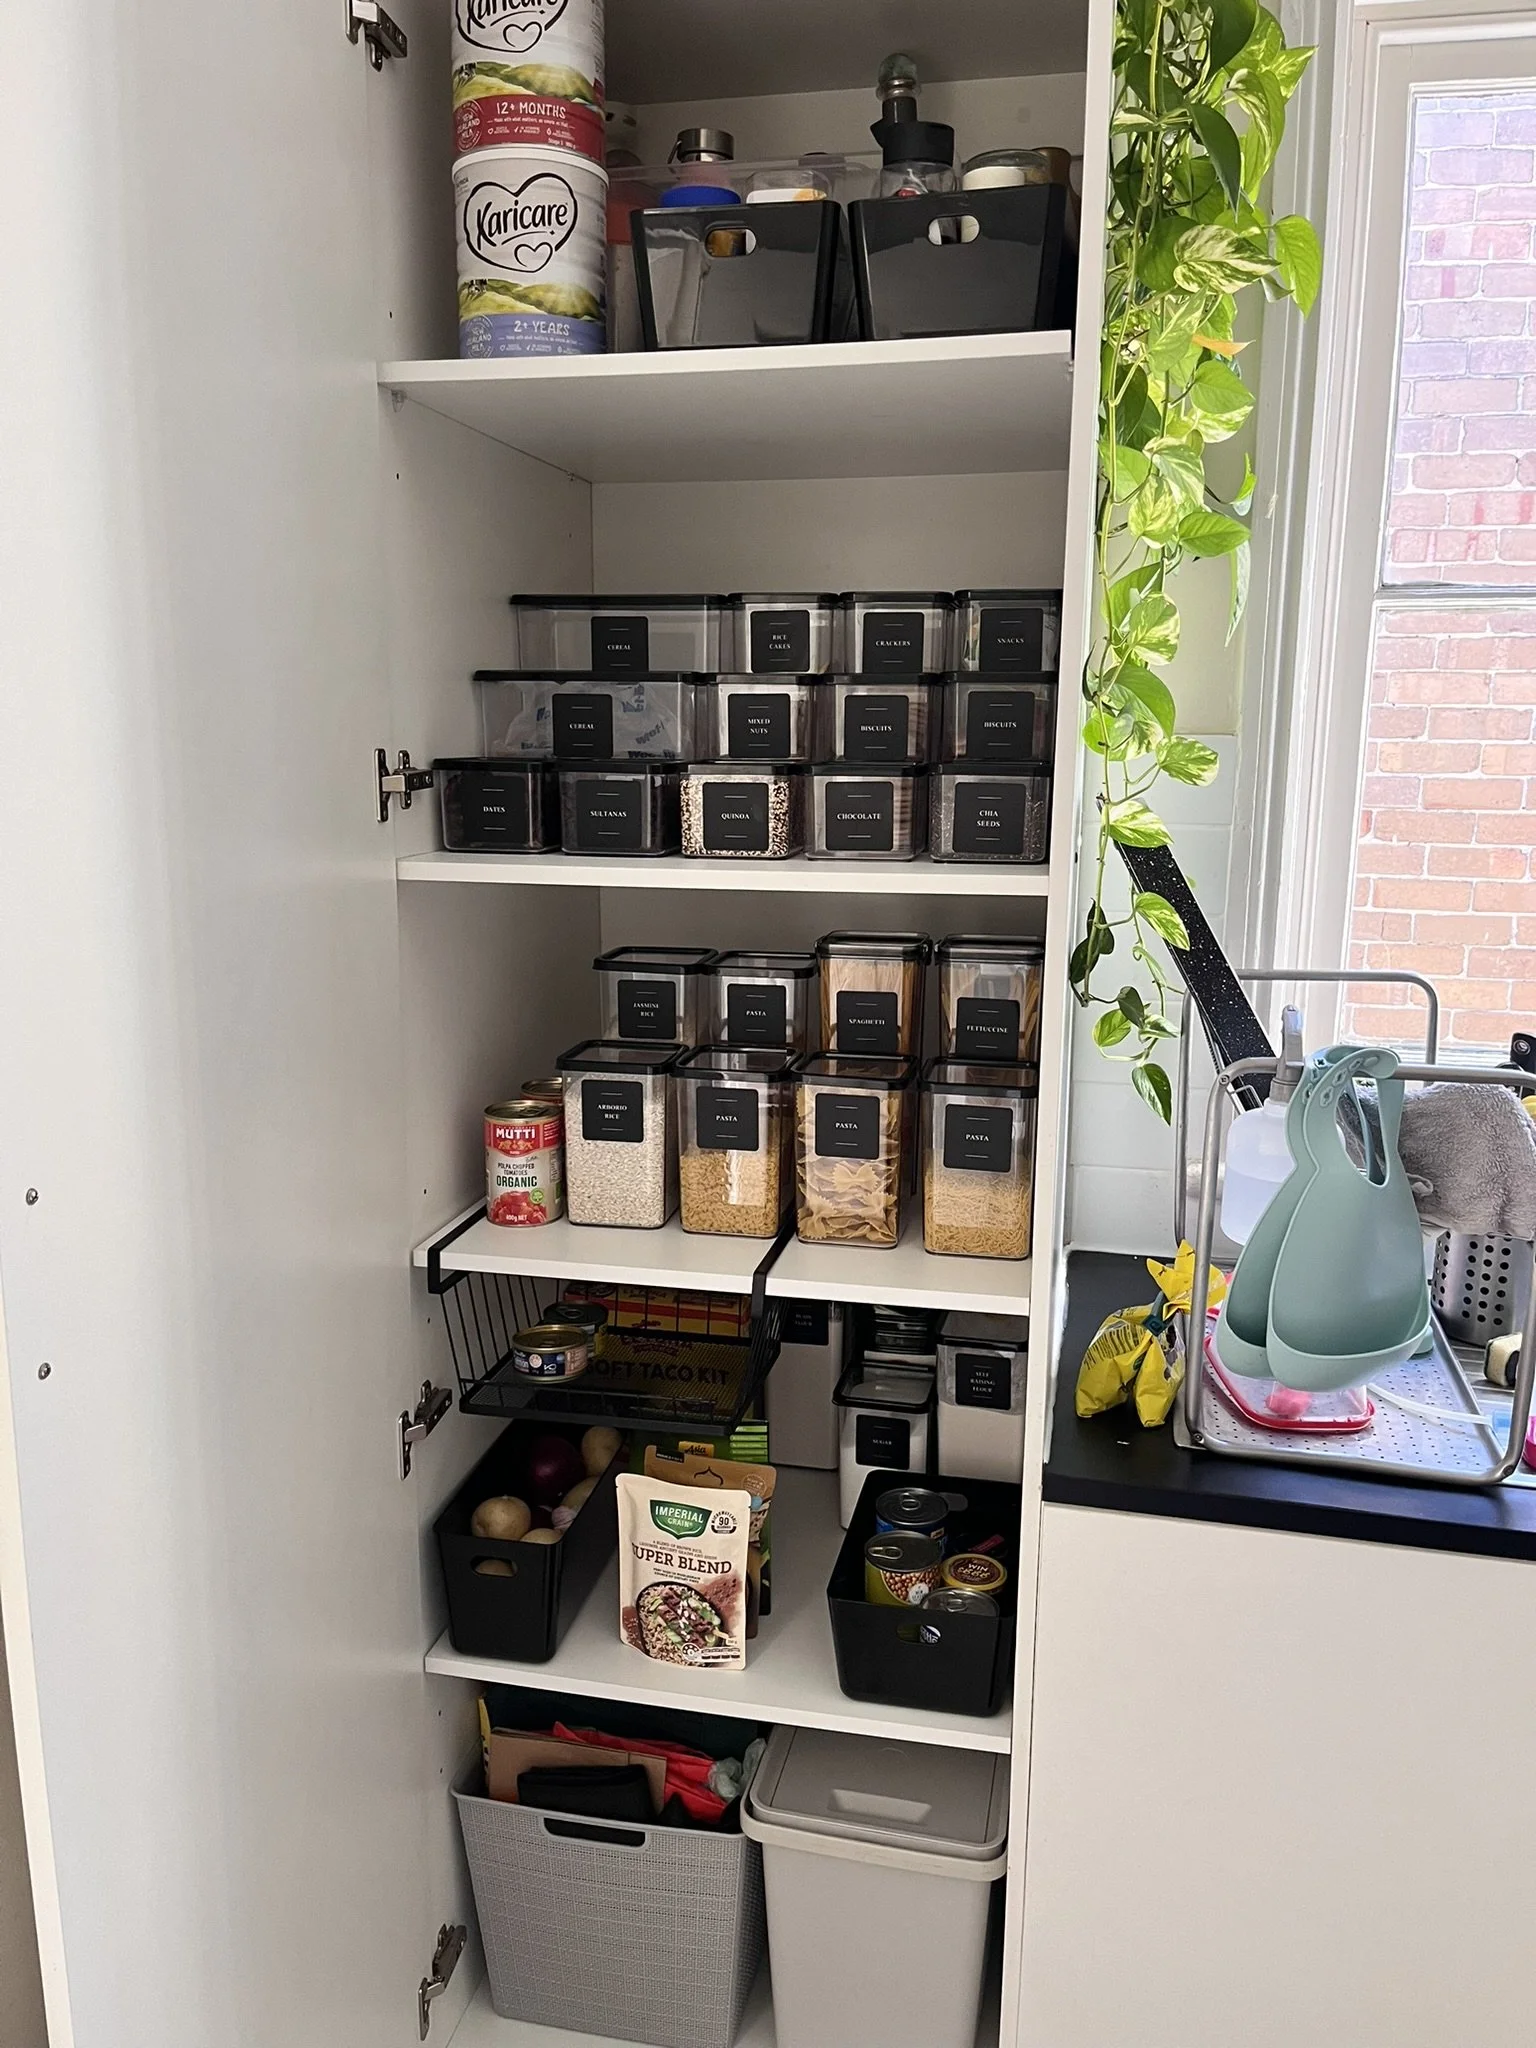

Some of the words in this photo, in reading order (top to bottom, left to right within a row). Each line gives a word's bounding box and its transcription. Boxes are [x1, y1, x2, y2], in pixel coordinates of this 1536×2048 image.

[496, 102, 515, 115] 12+
[519, 102, 566, 119] MONTHS
[477, 200, 568, 251] Karicare
[514, 320, 528, 333] 2+
[532, 320, 570, 336] YEARS
[966, 1025, 1008, 1033] FETTUCCINE
[496, 1127, 535, 1139] MUTTI
[965, 1134, 989, 1142] PASTA
[496, 1175, 538, 1188] ORGANIC
[640, 1362, 694, 1382] TACO
[698, 1367, 729, 1385] KIT
[969, 1378, 996, 1386] RAISING
[655, 1505, 704, 1524] IMPERIAL
[667, 1517, 690, 1528] GRAIN
[718, 1516, 729, 1526] 90
[678, 1555, 732, 1574] BLEND
[968, 1563, 989, 1572] WIN
